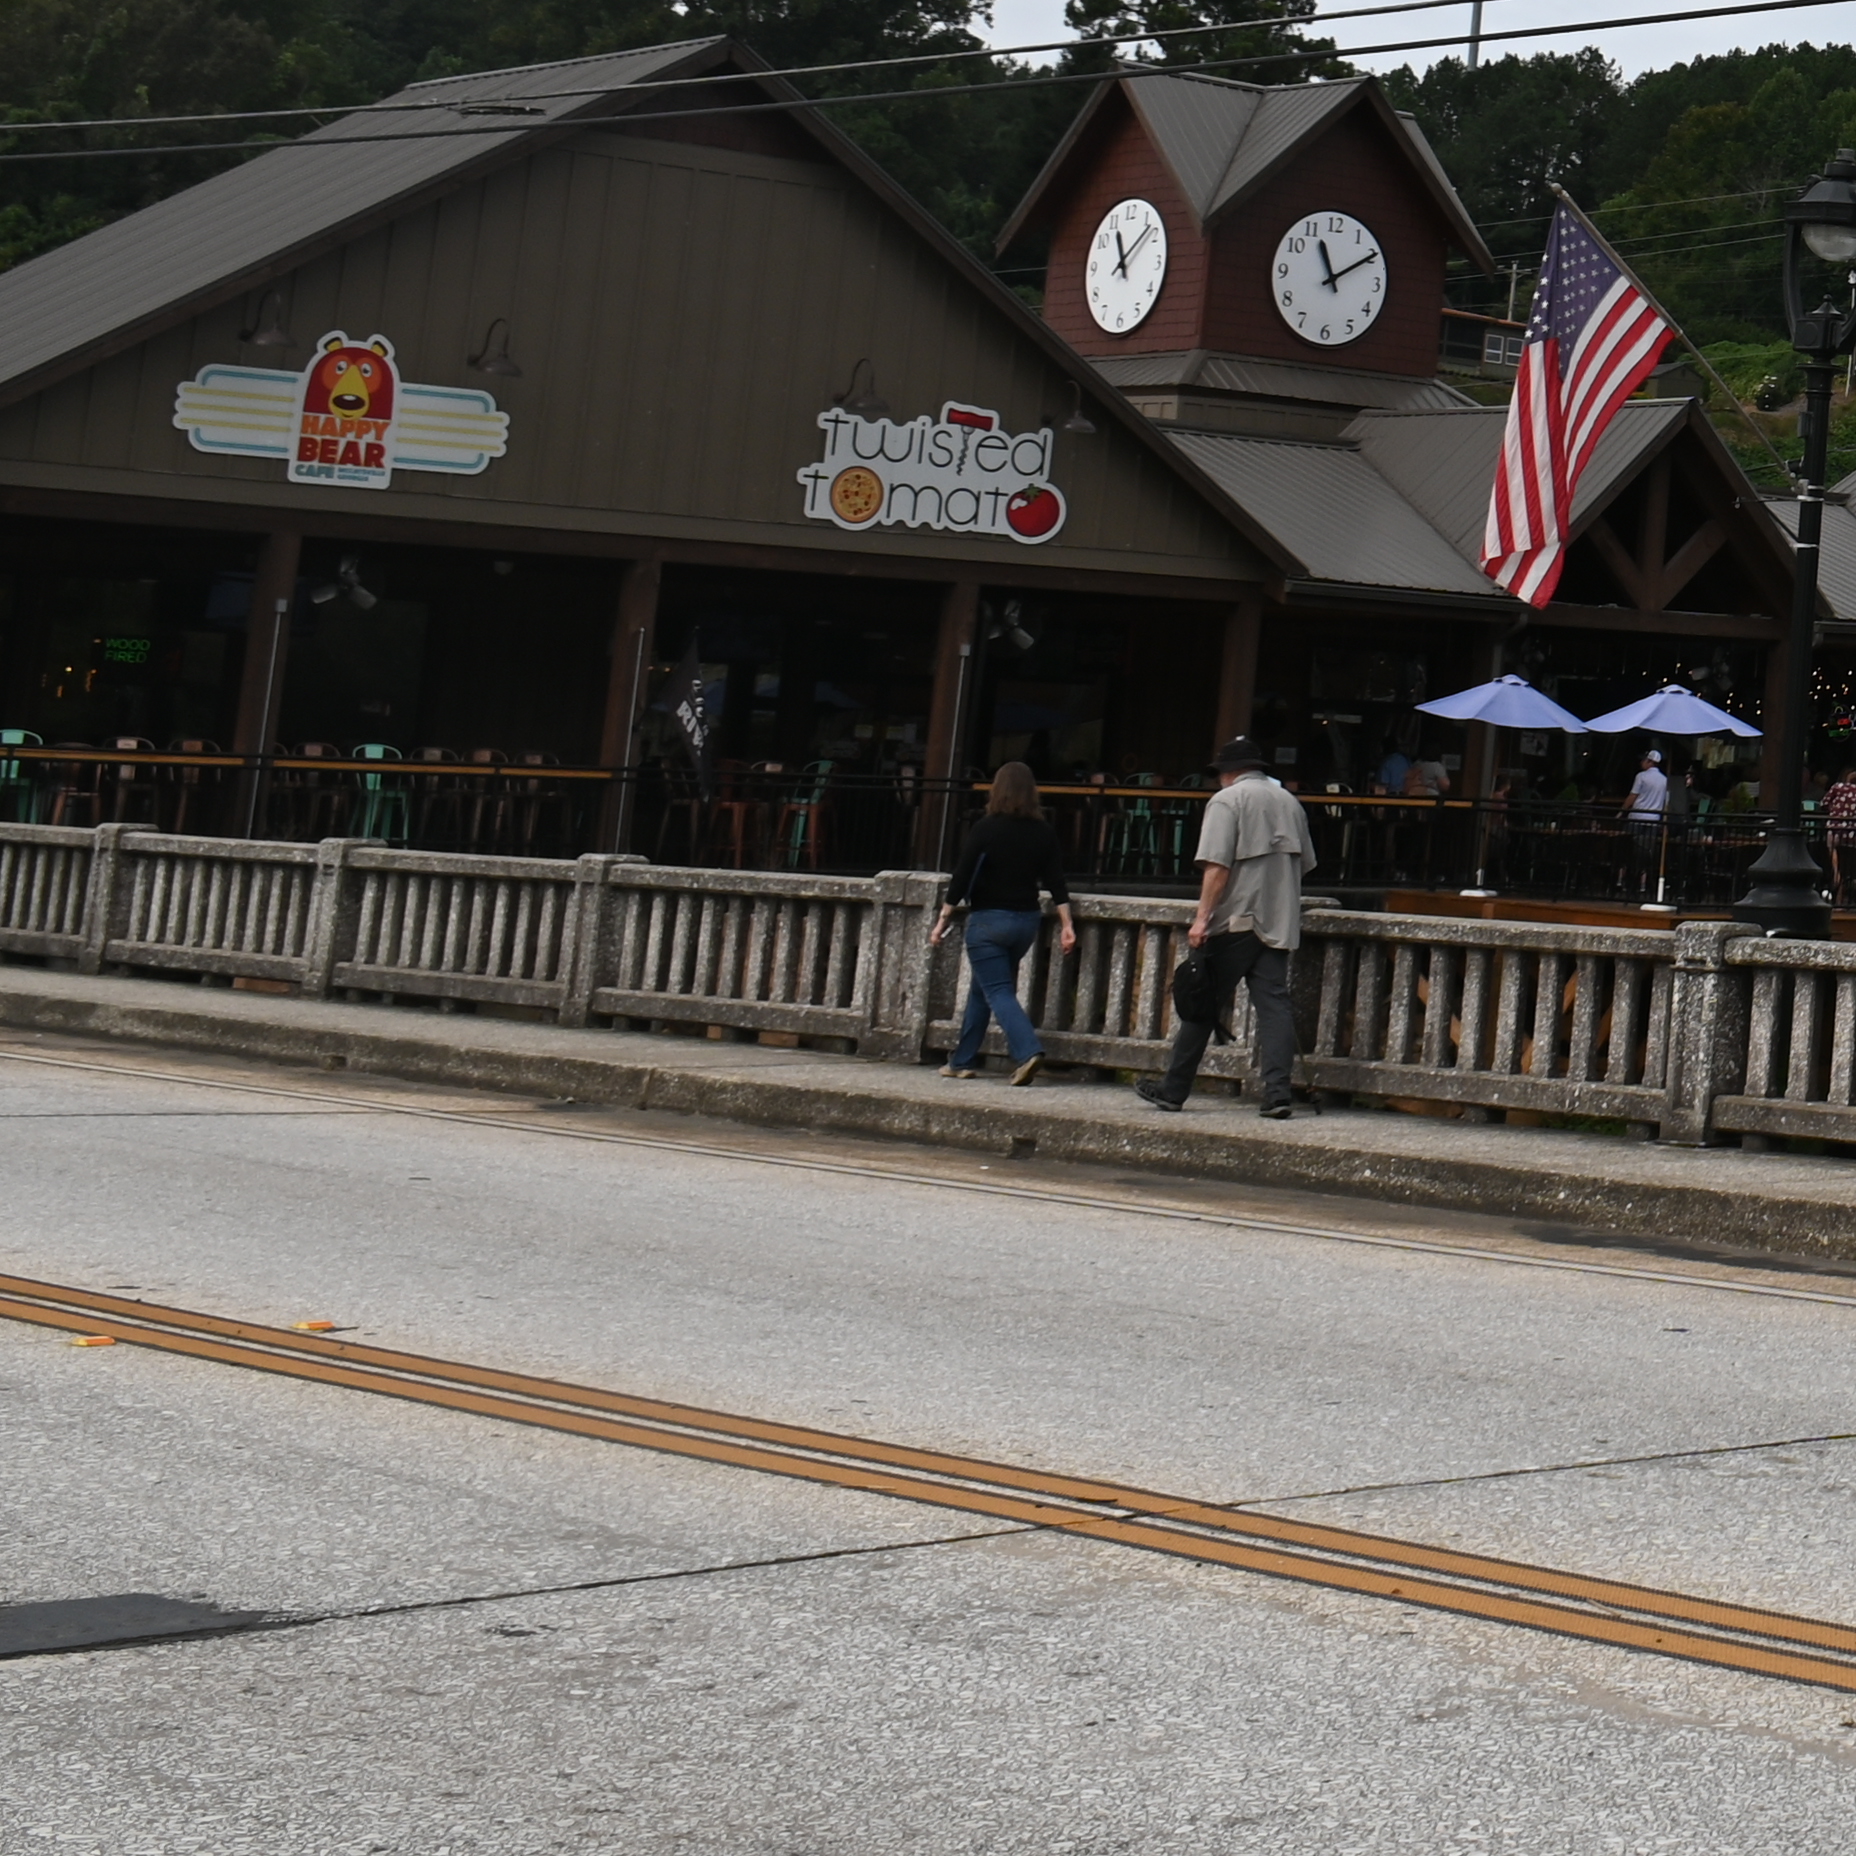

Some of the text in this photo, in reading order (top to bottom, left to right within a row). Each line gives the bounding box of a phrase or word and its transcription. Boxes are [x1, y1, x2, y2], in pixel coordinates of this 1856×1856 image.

[1125, 204, 1137, 221] 12
[1144, 211, 1149, 226] 1
[1109, 214, 1119, 230] 11
[1305, 221, 1318, 237] 11
[1327, 217, 1344, 233] 12
[1097, 233, 1110, 250] 10
[1151, 227, 1159, 243] 2
[1355, 229, 1361, 245] 1
[1287, 237, 1305, 254] 10
[1154, 254, 1162, 271] 3
[1366, 248, 1377, 264] 2
[1090, 261, 1098, 277] 9
[1278, 263, 1289, 279] 9
[1146, 280, 1153, 297] 4
[1371, 276, 1381, 293] 3
[1092, 286, 1100, 303] 8
[1282, 290, 1293, 307] 8
[1101, 304, 1108, 321] 7
[1133, 302, 1141, 318] 5
[1361, 300, 1371, 317] 4
[1116, 311, 1124, 328] 6
[1297, 311, 1307, 329] 7
[1344, 319, 1354, 335] 5
[1320, 324, 1331, 341] 6
[301, 415, 391, 441] HAPPY
[297, 437, 386, 468] BEAR
[106, 639, 151, 651] WOOD
[105, 650, 147, 663] FIRED
